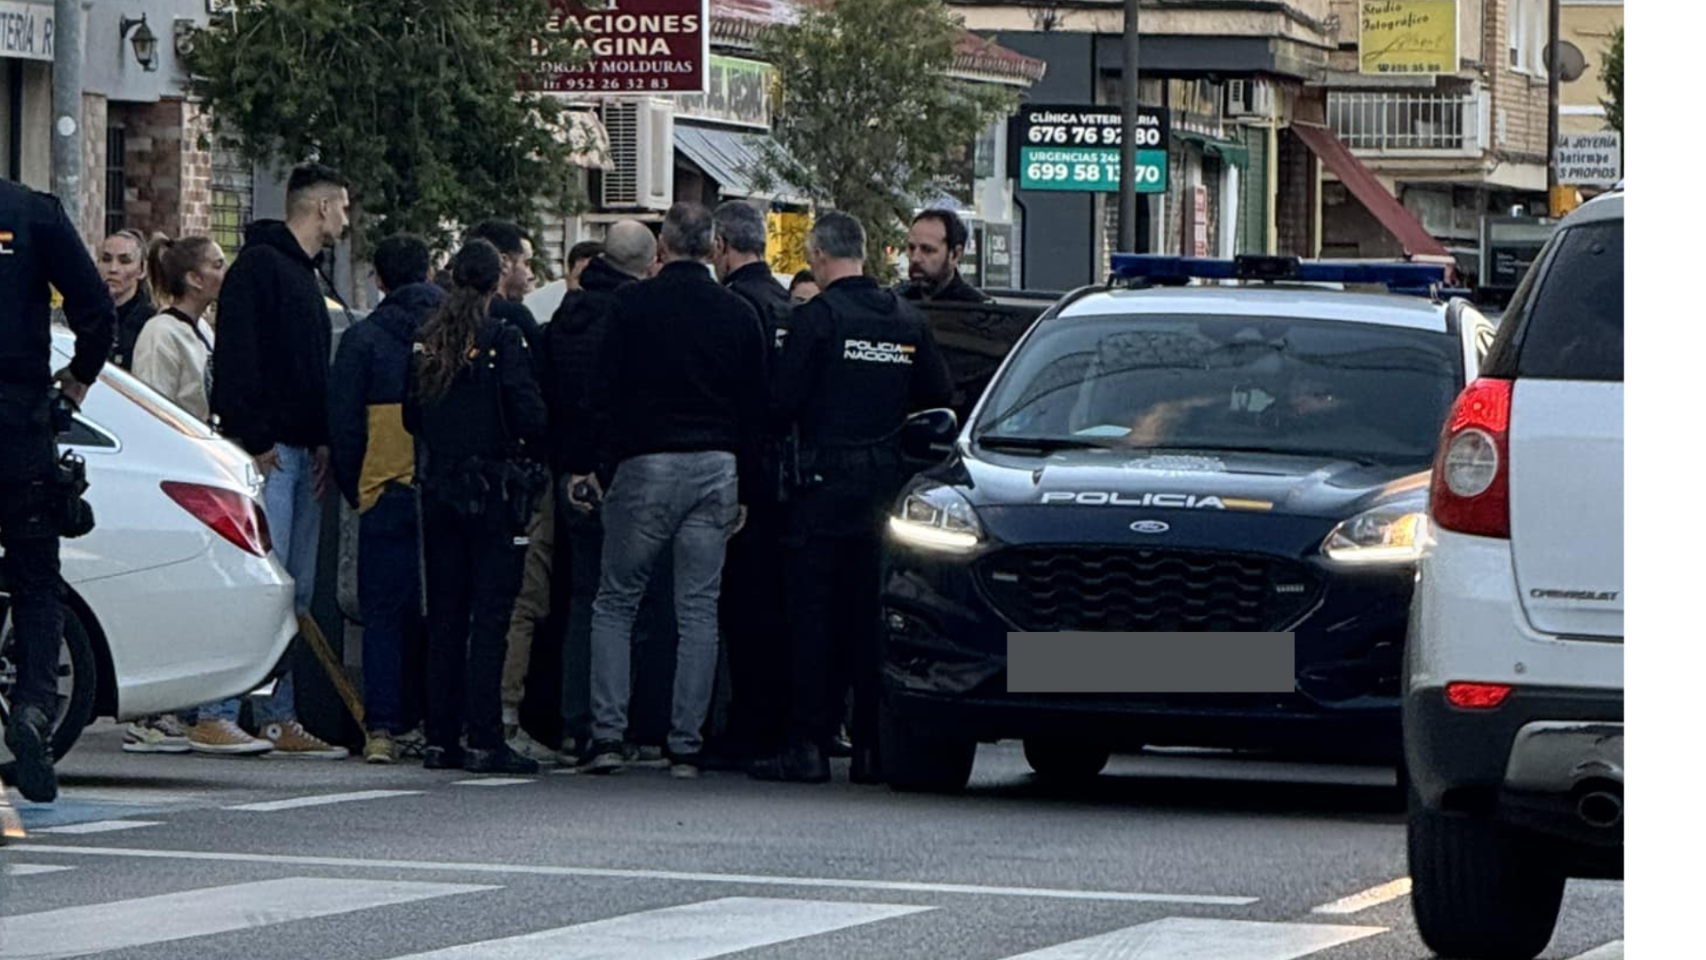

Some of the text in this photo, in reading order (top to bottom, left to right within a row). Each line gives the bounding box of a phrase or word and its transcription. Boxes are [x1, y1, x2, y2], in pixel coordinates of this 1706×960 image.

[1362, 0, 1402, 15] Studio
[530, 37, 671, 56] IAGINA
[588, 61, 599, 73] Y
[601, 61, 693, 73] MOLDURAS
[566, 78, 595, 89] 952
[601, 78, 619, 89] 26
[626, 78, 645, 89] 32
[651, 78, 669, 89] 83
[1029, 111, 1159, 125] CLÍNICA VETERIRIA
[1028, 125, 1068, 143] 676
[1071, 126, 1098, 144] 76
[1029, 152, 1098, 163] URGENCIAS
[1027, 163, 1069, 180] 699
[1073, 164, 1100, 182] 58
[1134, 165, 1160, 183] 70
[1568, 167, 1616, 179] PROPIOS
[844, 339, 902, 353] POLICIA
[843, 350, 913, 364] NACIONAL
[1040, 491, 1226, 509] POLICIA
